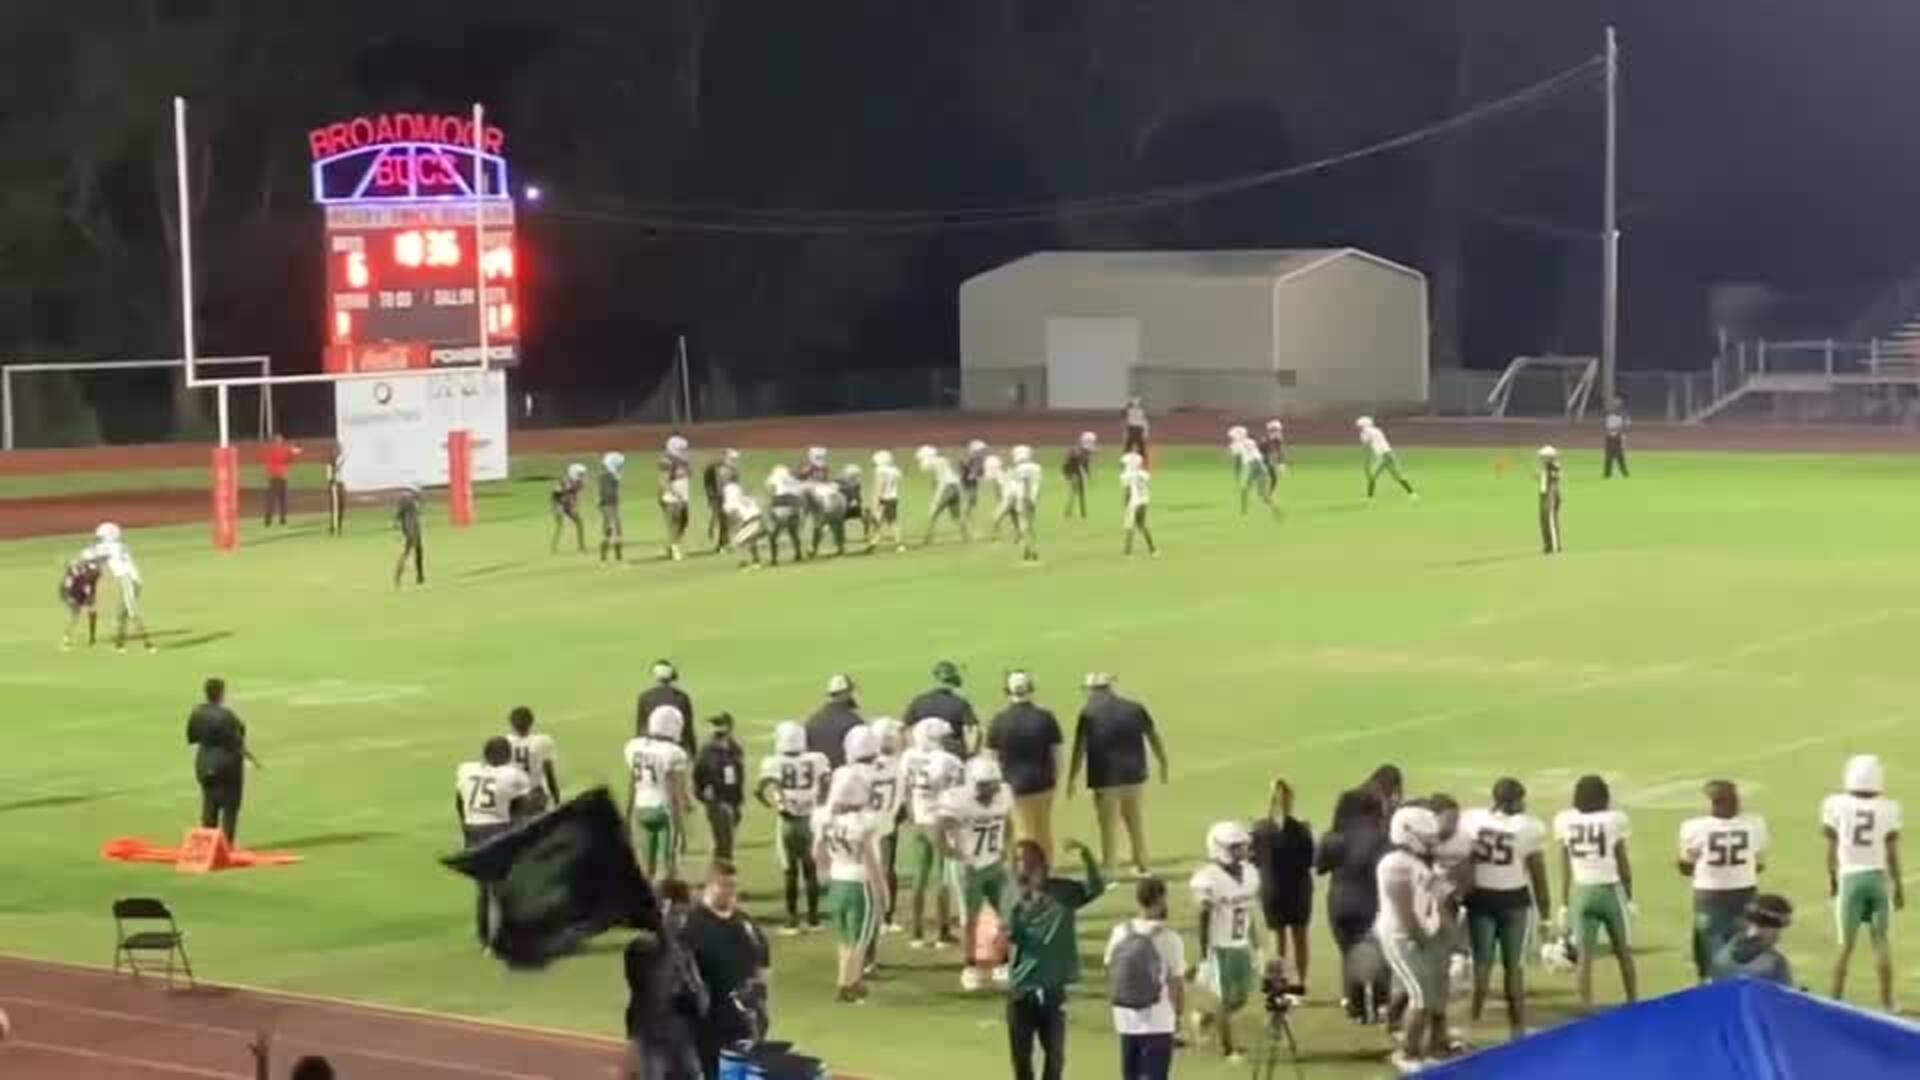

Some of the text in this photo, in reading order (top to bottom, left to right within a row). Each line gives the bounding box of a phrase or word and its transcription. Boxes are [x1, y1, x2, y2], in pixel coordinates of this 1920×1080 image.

[309, 113, 504, 160] BROADMOOR
[376, 156, 459, 187] BUCS
[781, 761, 814, 790] 83
[468, 776, 497, 811] 75
[1568, 822, 1606, 858] 24
[1853, 810, 1875, 846] 2
[1473, 827, 1515, 865] 55
[1707, 831, 1749, 866] 52
